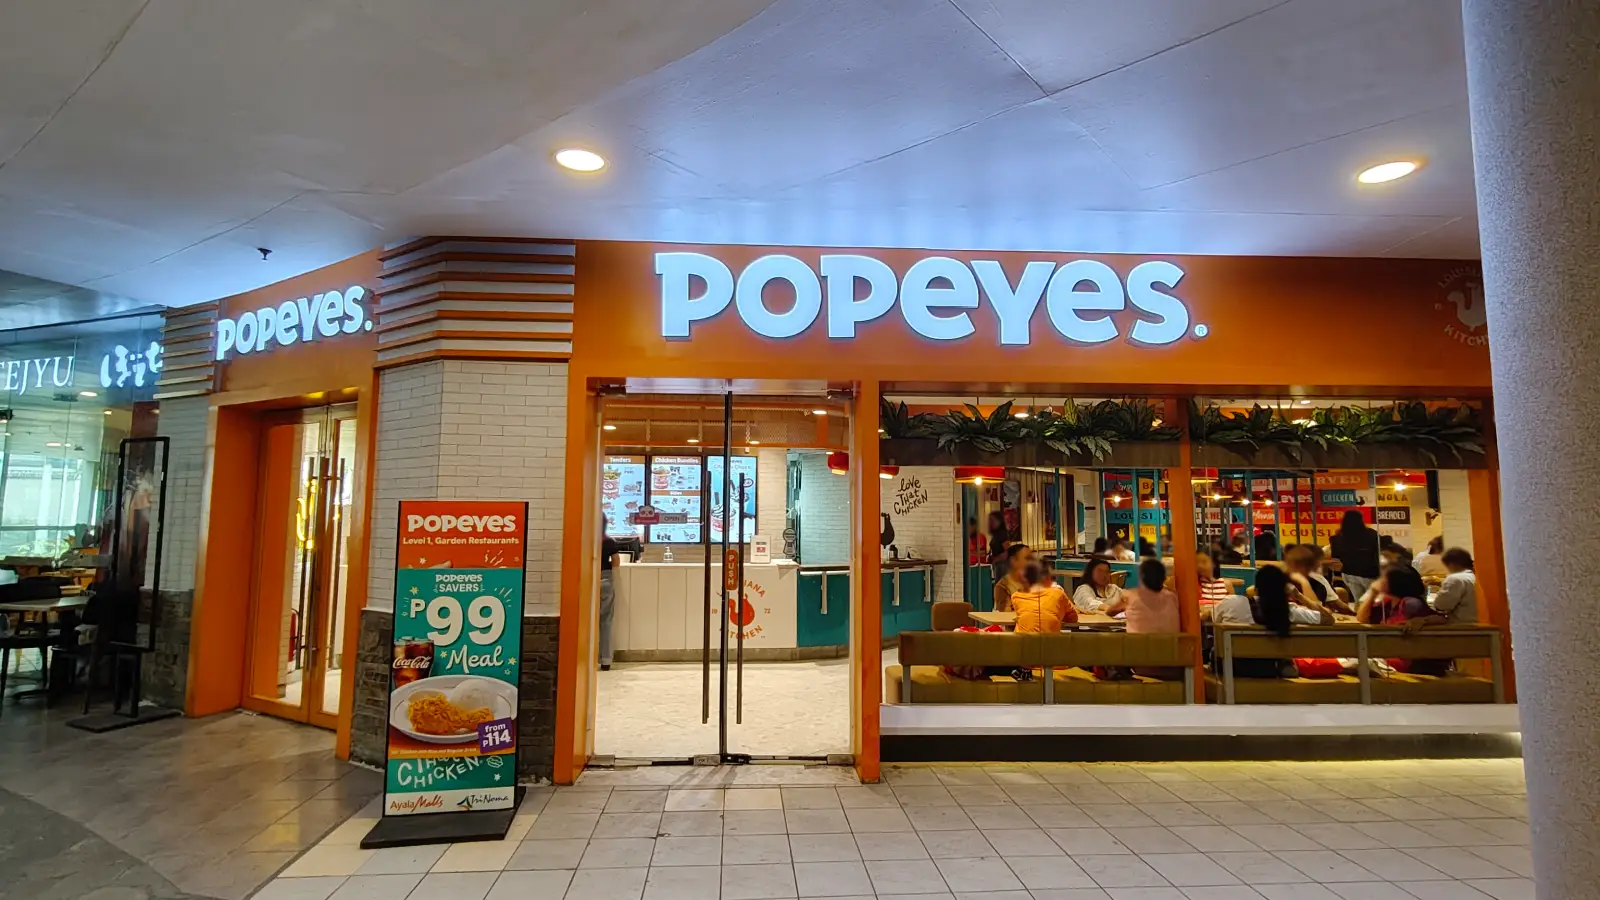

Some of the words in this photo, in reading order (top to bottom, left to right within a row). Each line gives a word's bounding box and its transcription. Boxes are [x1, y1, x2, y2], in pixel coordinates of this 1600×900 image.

[1444, 324, 1489, 348] KITCH
[0, 356, 74, 396] EJYU
[403, 537, 426, 545] Level
[435, 537, 467, 546] Garden
[468, 536, 519, 545] Restaurants
[439, 583, 479, 592] SAVERS
[445, 644, 504, 674] Meal
[485, 723, 506, 732] from
